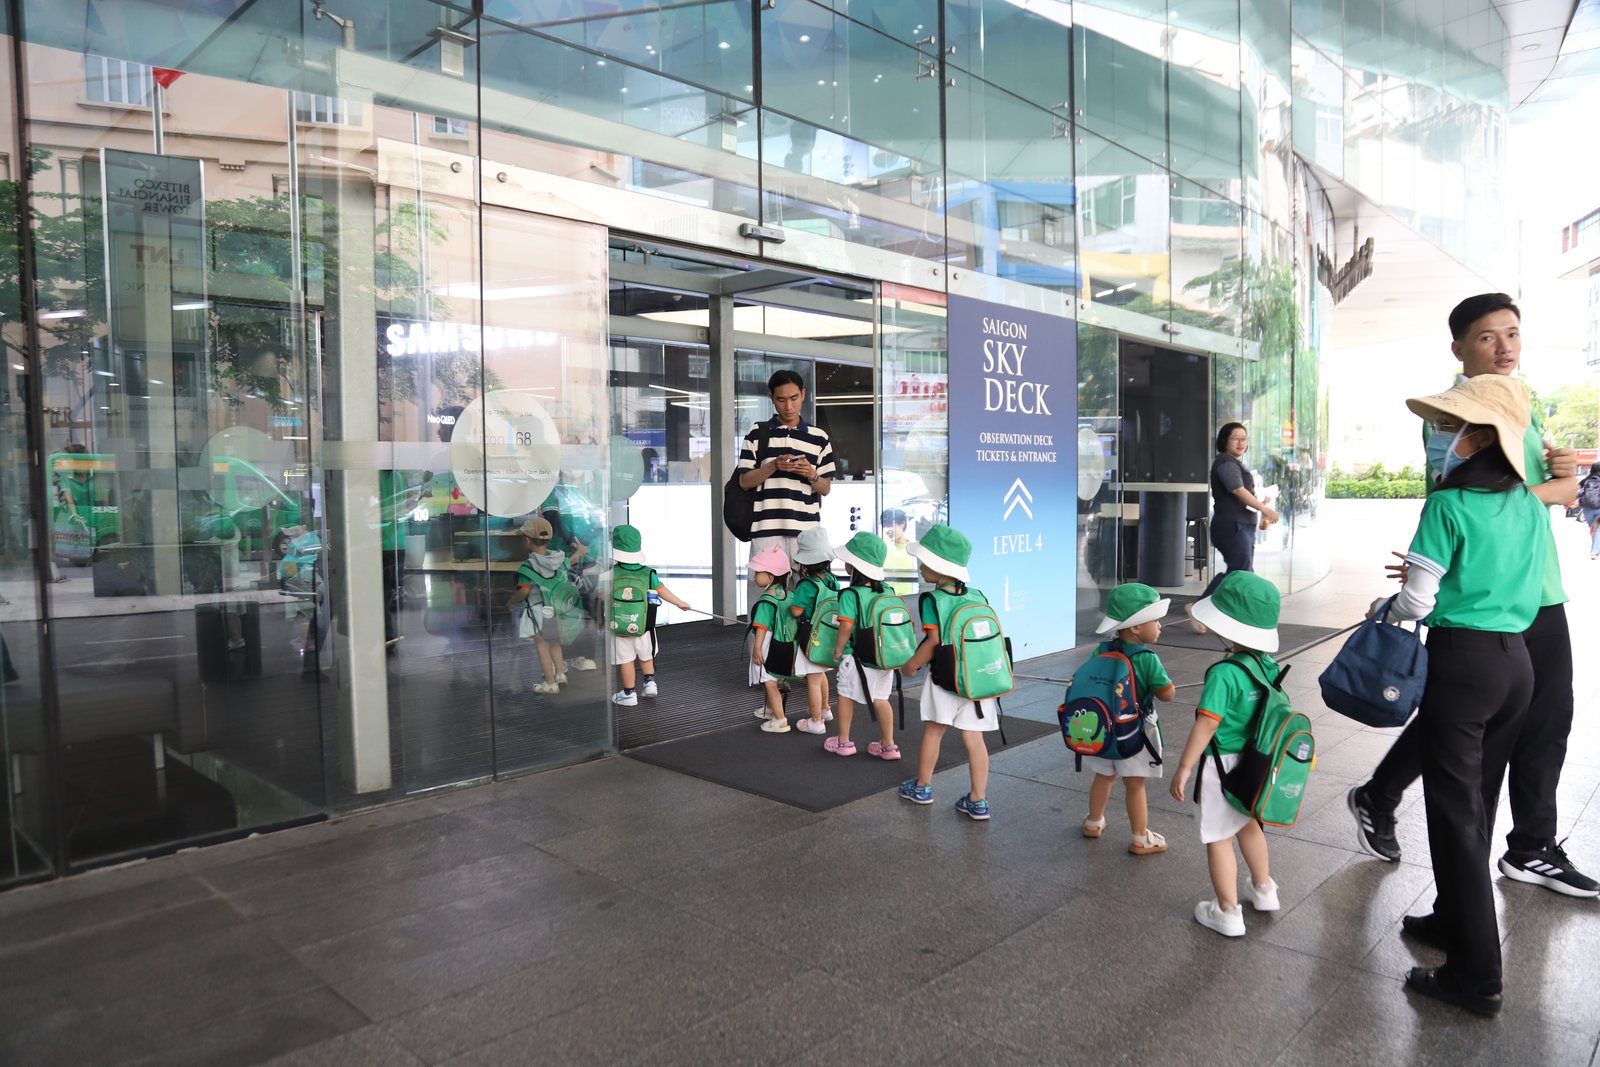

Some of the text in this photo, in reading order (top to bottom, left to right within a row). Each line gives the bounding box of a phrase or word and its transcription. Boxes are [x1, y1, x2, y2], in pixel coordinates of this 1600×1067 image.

[982, 317, 1027, 339] SAIGON
[983, 339, 1027, 376] SKY
[984, 378, 1052, 415] DECK
[427, 414, 455, 425] Neo QLED
[515, 431, 532, 447] 68
[980, 432, 1053, 446] OBSERVATION DECK
[976, 450, 1057, 463] TICKETS & ENTRANCE
[993, 532, 1043, 555] LEVEL 4
